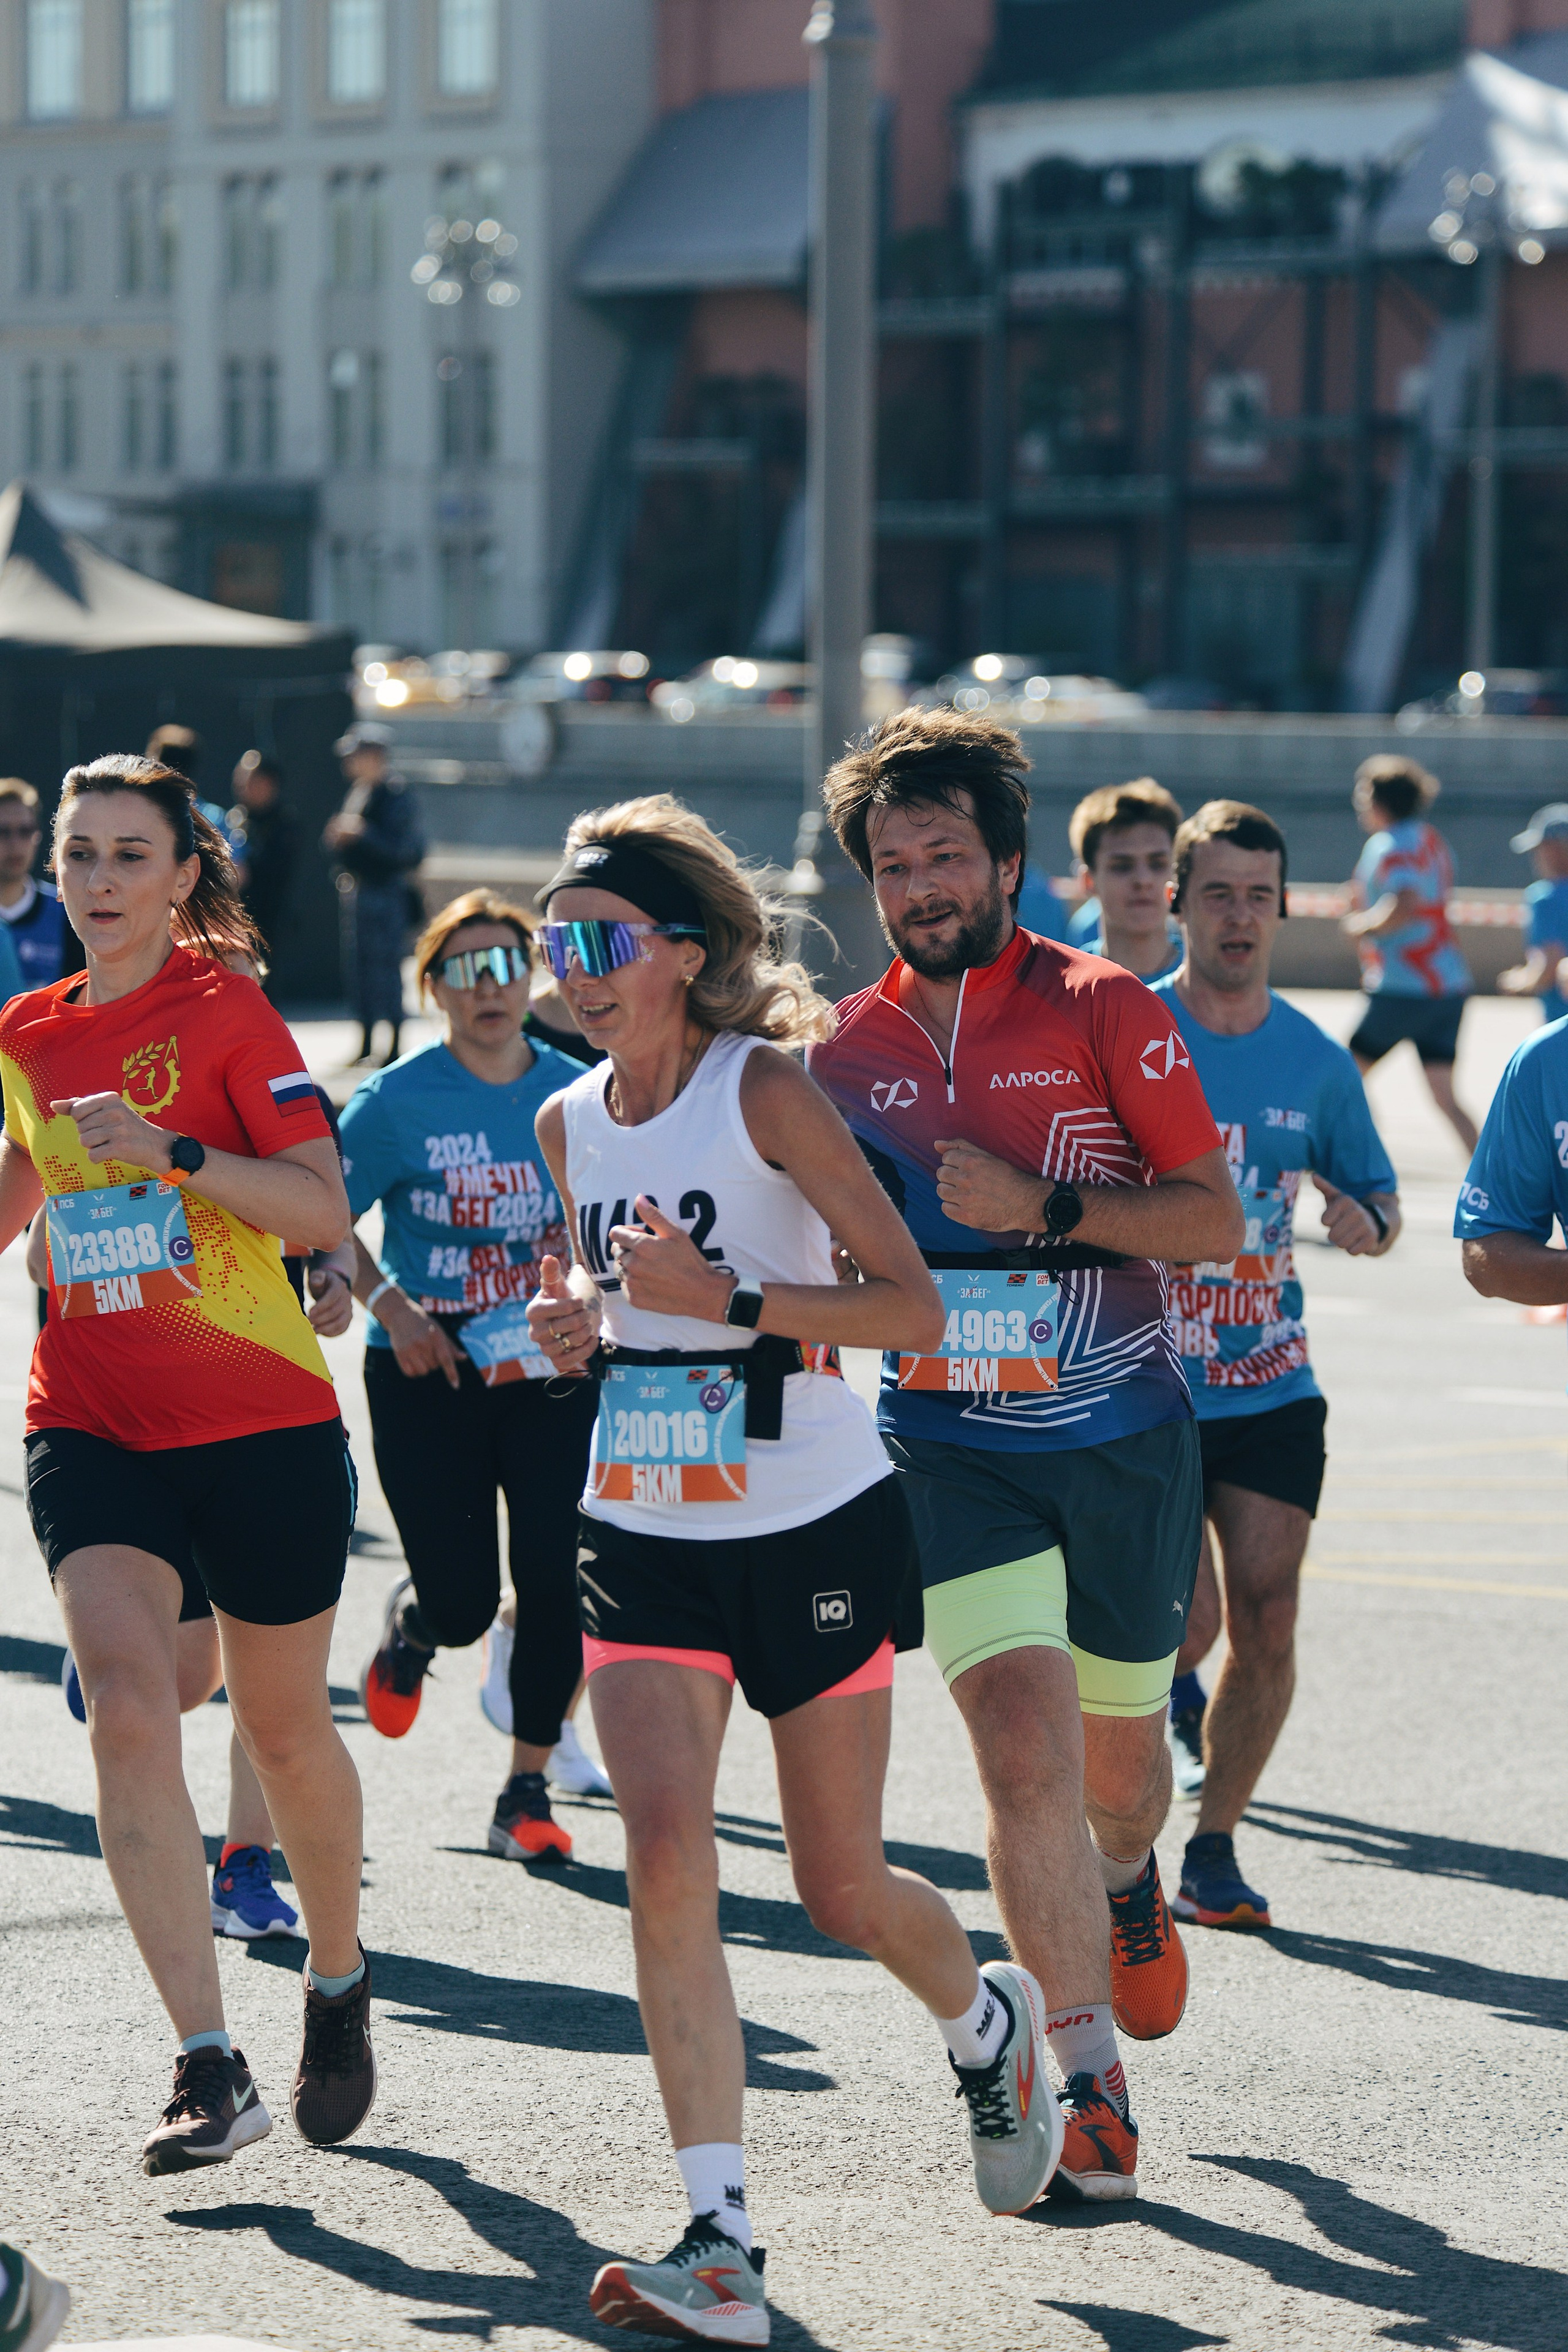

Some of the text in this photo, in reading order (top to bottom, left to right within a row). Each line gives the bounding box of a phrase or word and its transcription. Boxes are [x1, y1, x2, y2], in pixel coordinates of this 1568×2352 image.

[425, 1131, 492, 1169] 2024
[69, 1223, 161, 1276] 23388
[92, 1274, 144, 1314] 5KM
[938, 1309, 1027, 1352] 4963
[947, 1357, 999, 1392] 5KM
[614, 1409, 708, 1458] 20016
[631, 1464, 683, 1502] 5KM
